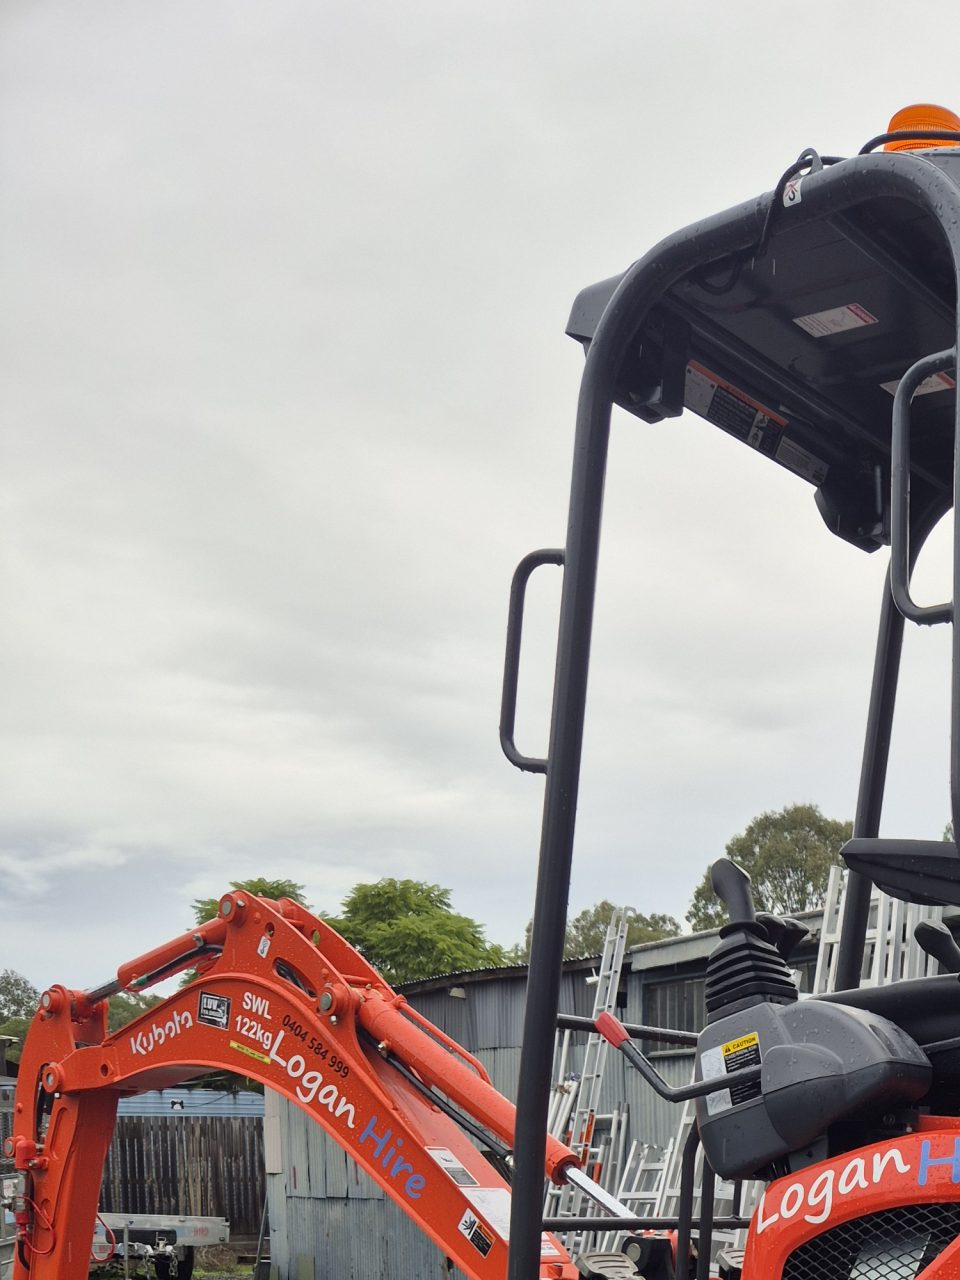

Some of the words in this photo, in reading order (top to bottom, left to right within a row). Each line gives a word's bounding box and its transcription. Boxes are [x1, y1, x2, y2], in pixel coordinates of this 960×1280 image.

[242, 991, 273, 1020] SWL
[130, 1010, 193, 1056] Kubota
[235, 1014, 273, 1050] 122kg
[282, 1014, 308, 1042] 0404
[307, 1037, 327, 1061] 584
[328, 1055, 350, 1079] 999
[732, 1037, 756, 1050] CAUTION
[269, 1029, 355, 1129] Logan
[358, 1115, 426, 1199] Hire
[756, 1148, 911, 1235] Logan
